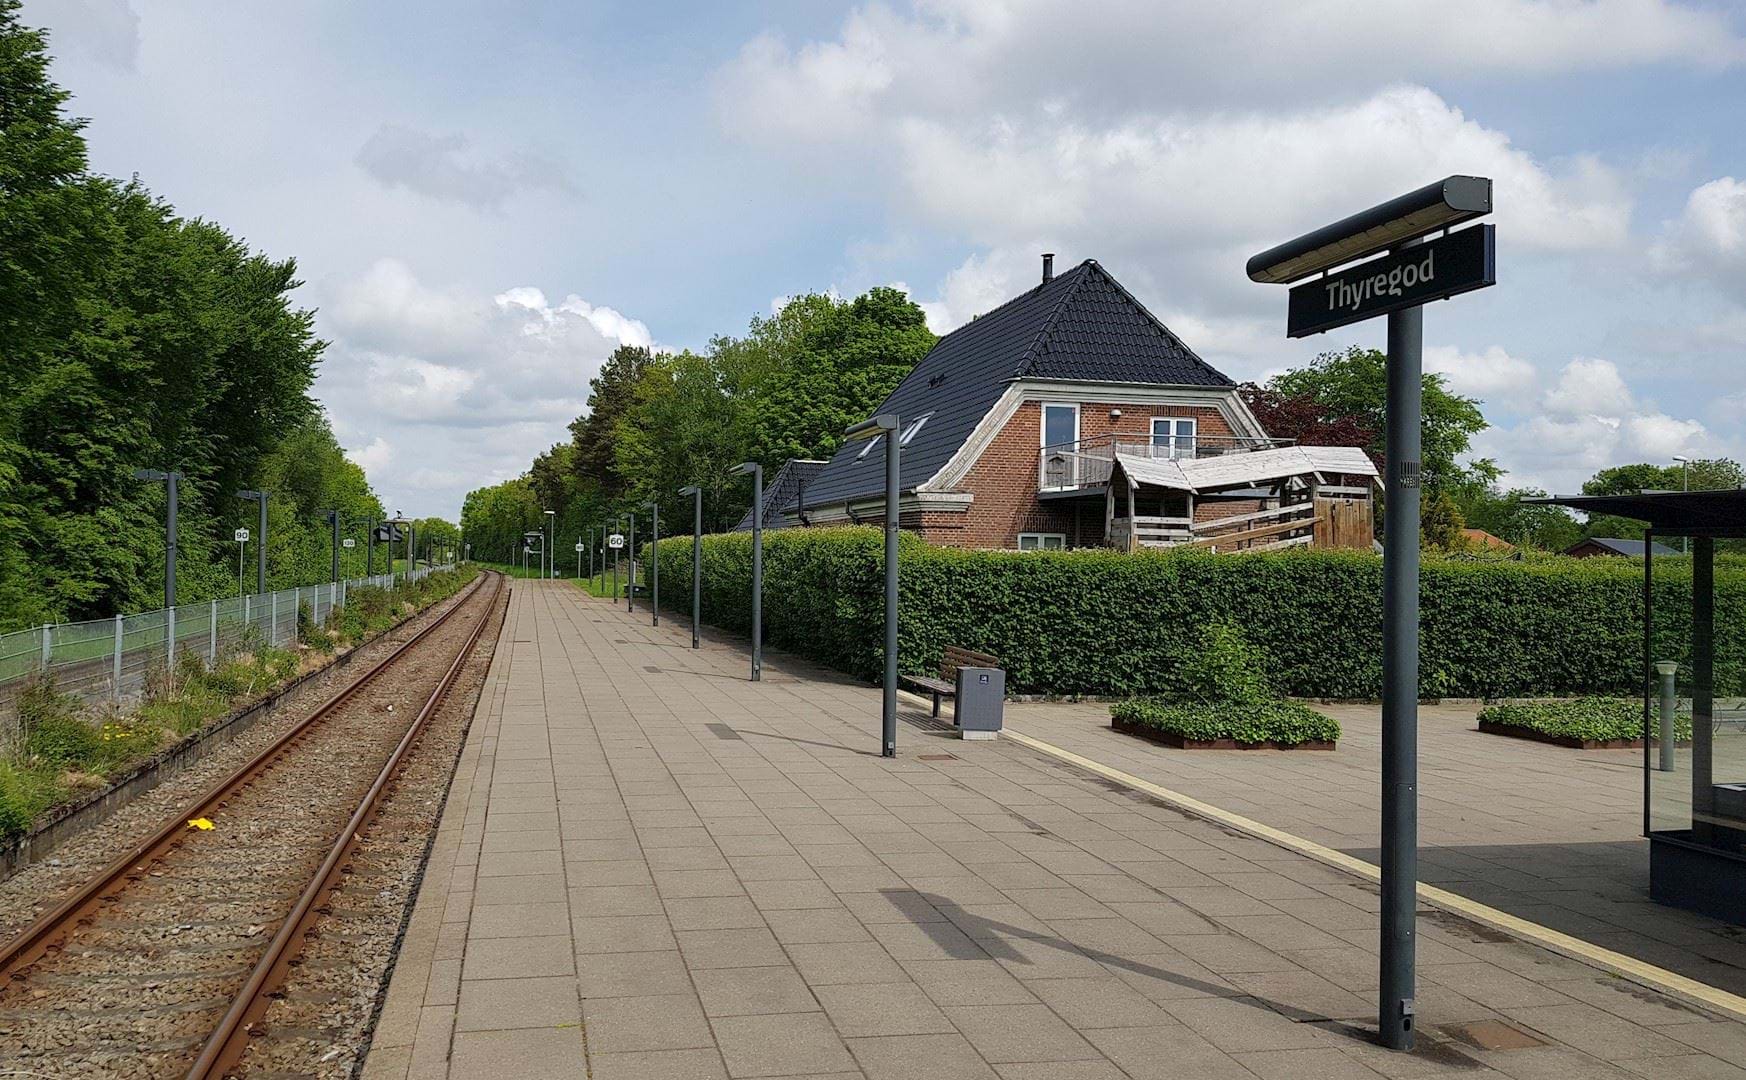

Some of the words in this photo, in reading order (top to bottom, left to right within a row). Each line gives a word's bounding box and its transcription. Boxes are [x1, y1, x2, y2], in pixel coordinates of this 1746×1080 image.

[1325, 249, 1435, 311] Thyregod
[236, 531, 248, 539] 90
[610, 537, 622, 545] 60
